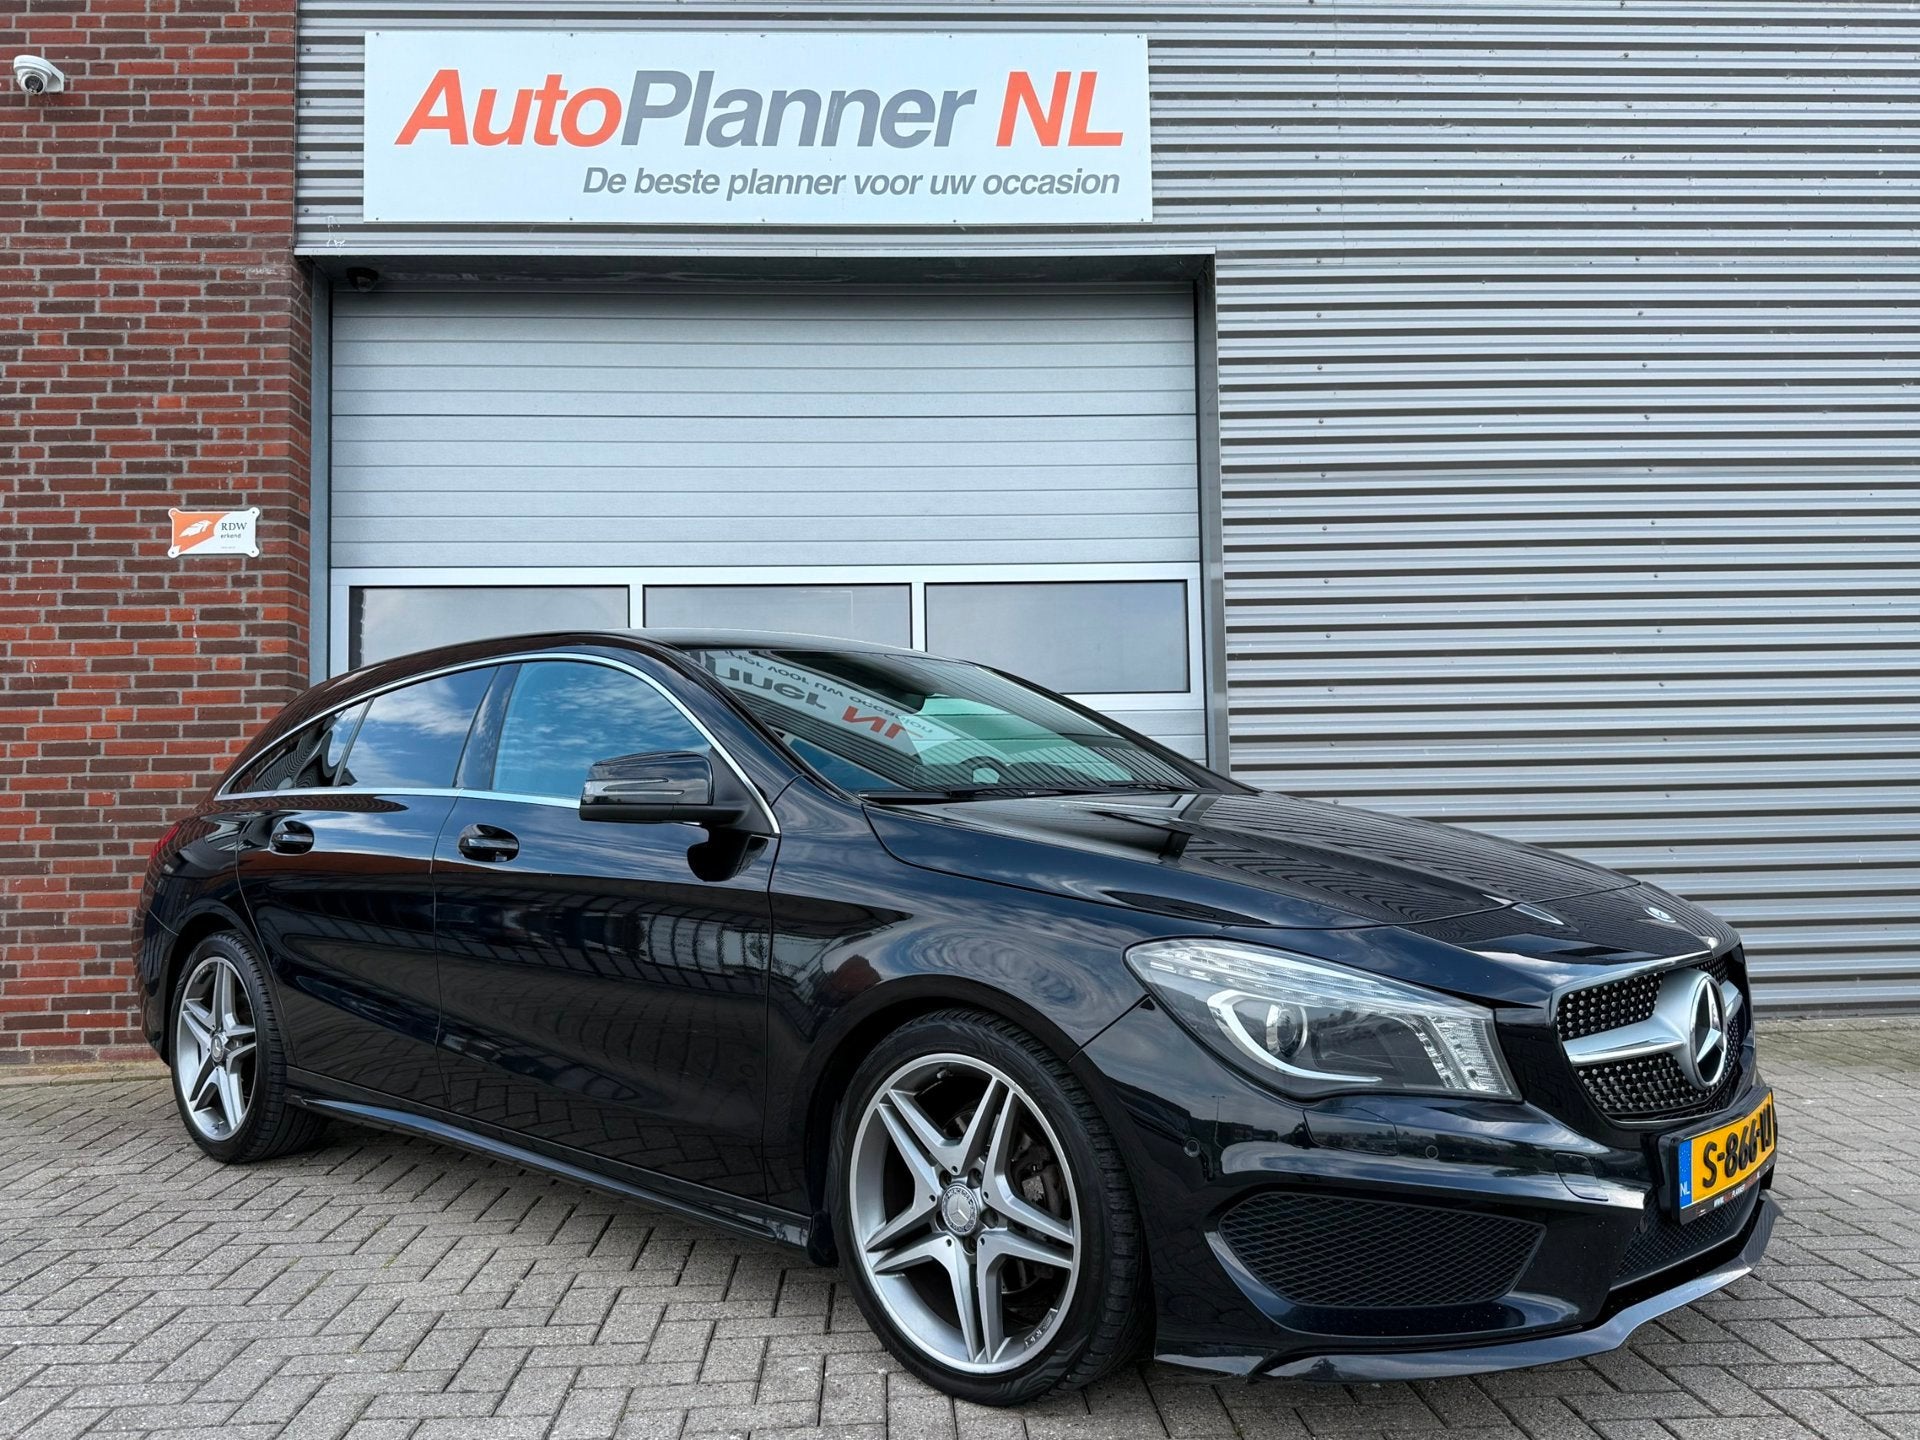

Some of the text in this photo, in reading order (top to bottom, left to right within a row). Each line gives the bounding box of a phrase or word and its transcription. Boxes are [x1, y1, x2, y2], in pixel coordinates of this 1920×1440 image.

[395, 69, 1124, 148] AutoPlanner NL
[583, 166, 1120, 202] De beste planner voor uw occasion
[221, 522, 247, 531] RDW
[1680, 1181, 1691, 1197] NL
